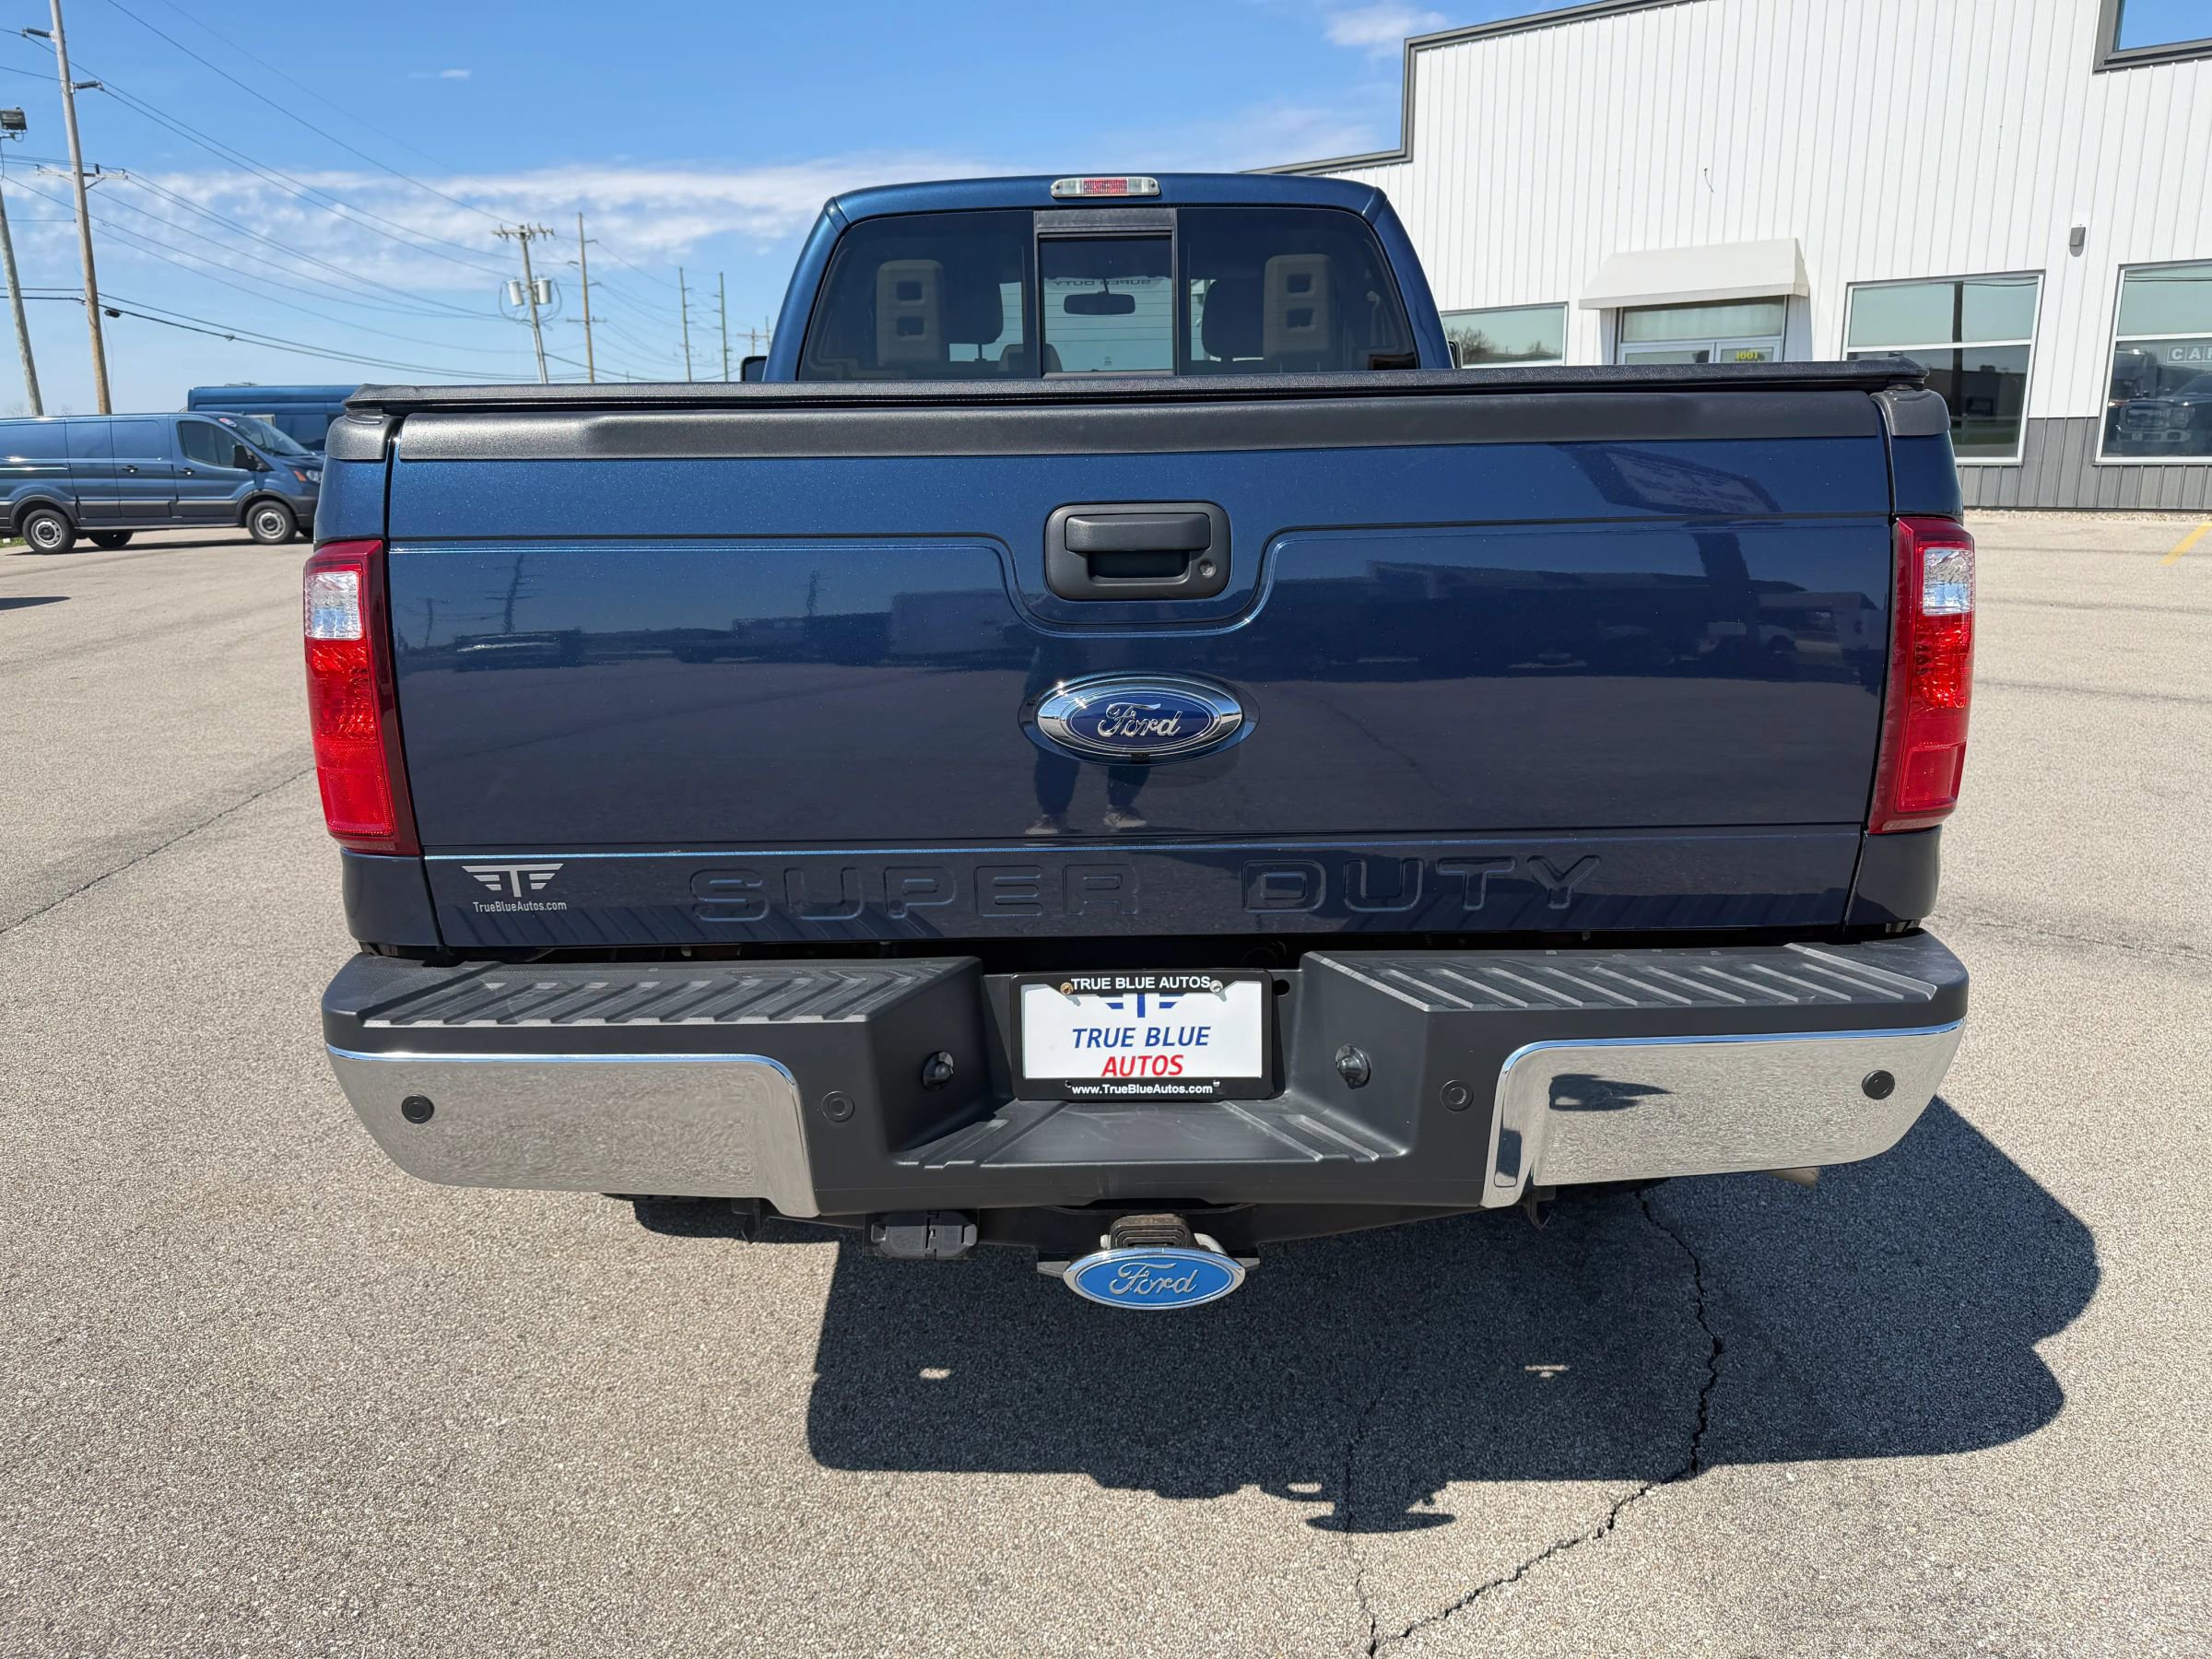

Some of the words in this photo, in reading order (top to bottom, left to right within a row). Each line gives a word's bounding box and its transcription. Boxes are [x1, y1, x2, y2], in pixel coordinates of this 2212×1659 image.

[1097, 702, 1183, 737] Ford
[689, 864, 1141, 922] SUPER
[1241, 854, 1603, 914] DUTY
[472, 900, 568, 912] TrueBlueAutos.com
[1071, 977, 1112, 991] TRUE
[1115, 977, 1156, 990] BLUE
[1159, 975, 1211, 990] AUTOS
[1072, 1027, 1136, 1049] TRUE
[1145, 1025, 1211, 1048] BLUE
[1100, 1053, 1184, 1077] AUTOS
[1071, 1083, 1214, 1095] www.TrueBlueAutos.com
[1108, 1262, 1199, 1296] Ford
